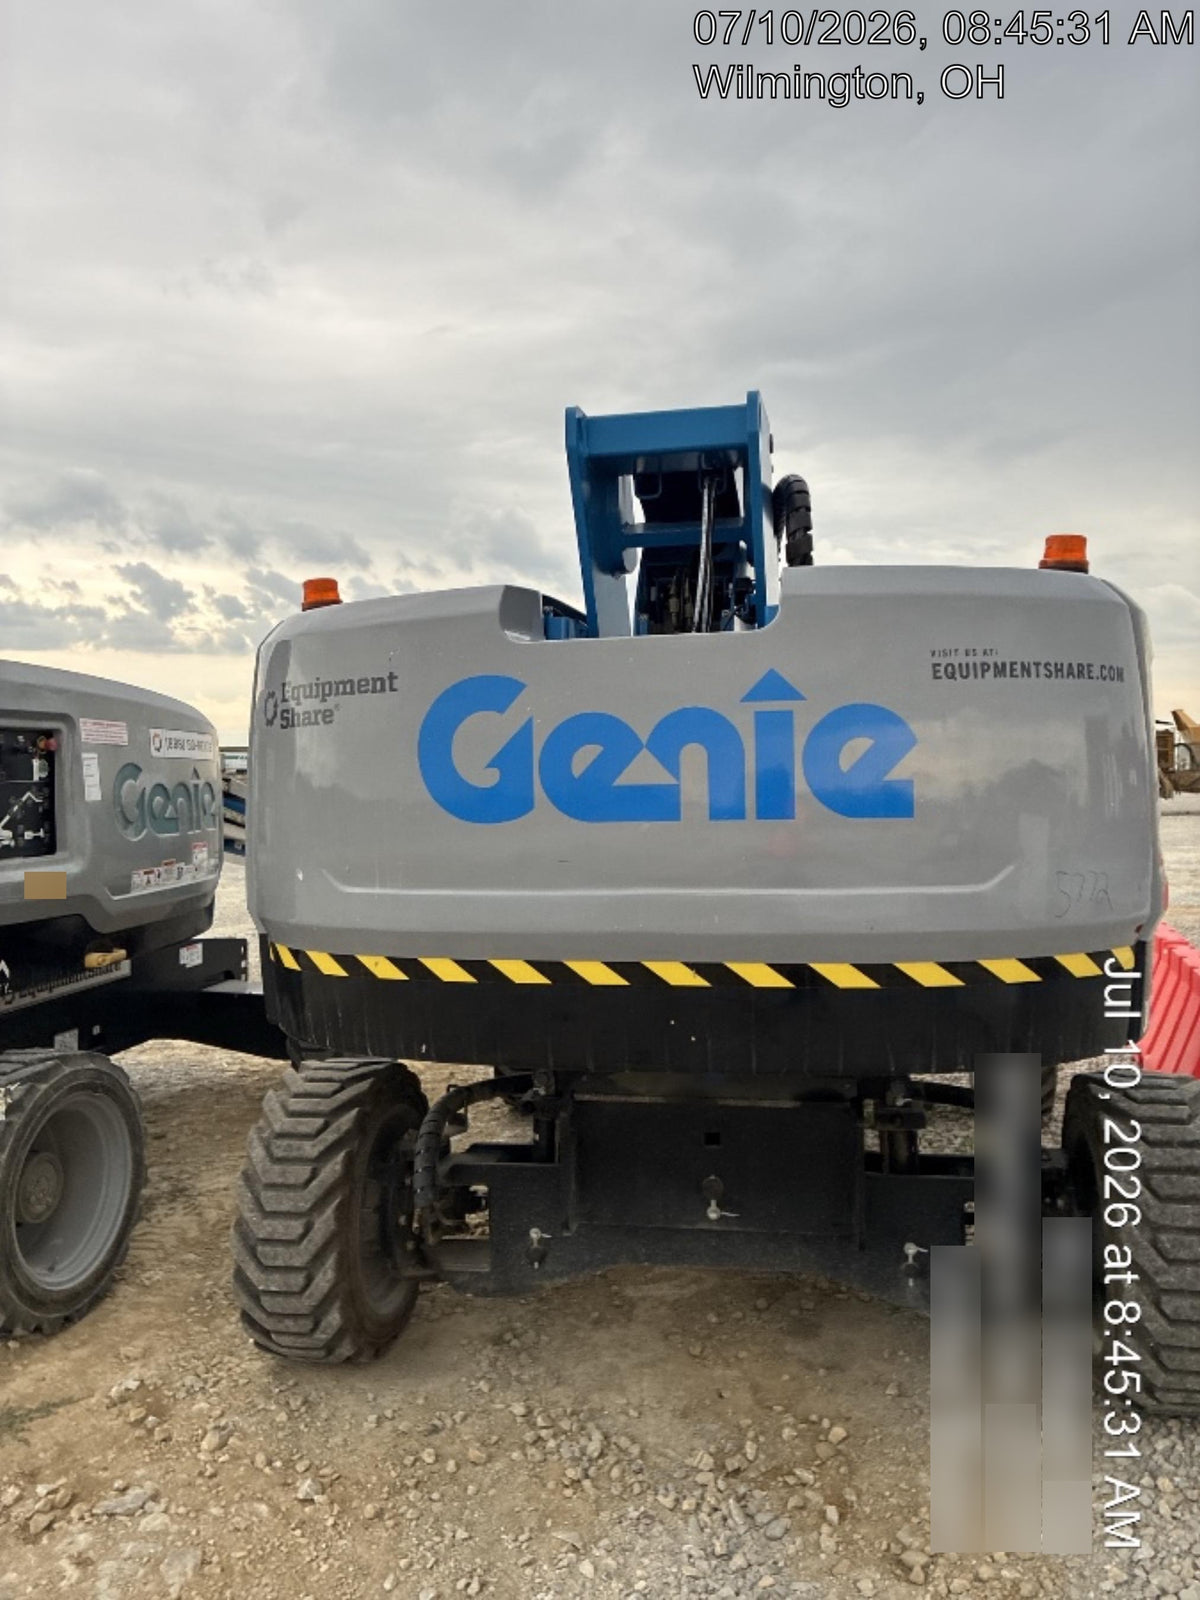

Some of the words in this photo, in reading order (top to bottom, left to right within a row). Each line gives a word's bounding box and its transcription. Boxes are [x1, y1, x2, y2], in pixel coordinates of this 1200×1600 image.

[280, 671, 399, 705] Equipment
[931, 661, 1125, 682] EQUIPMENTSHARE.COM
[417, 668, 918, 824] Genie
[113, 762, 217, 841] Genie
